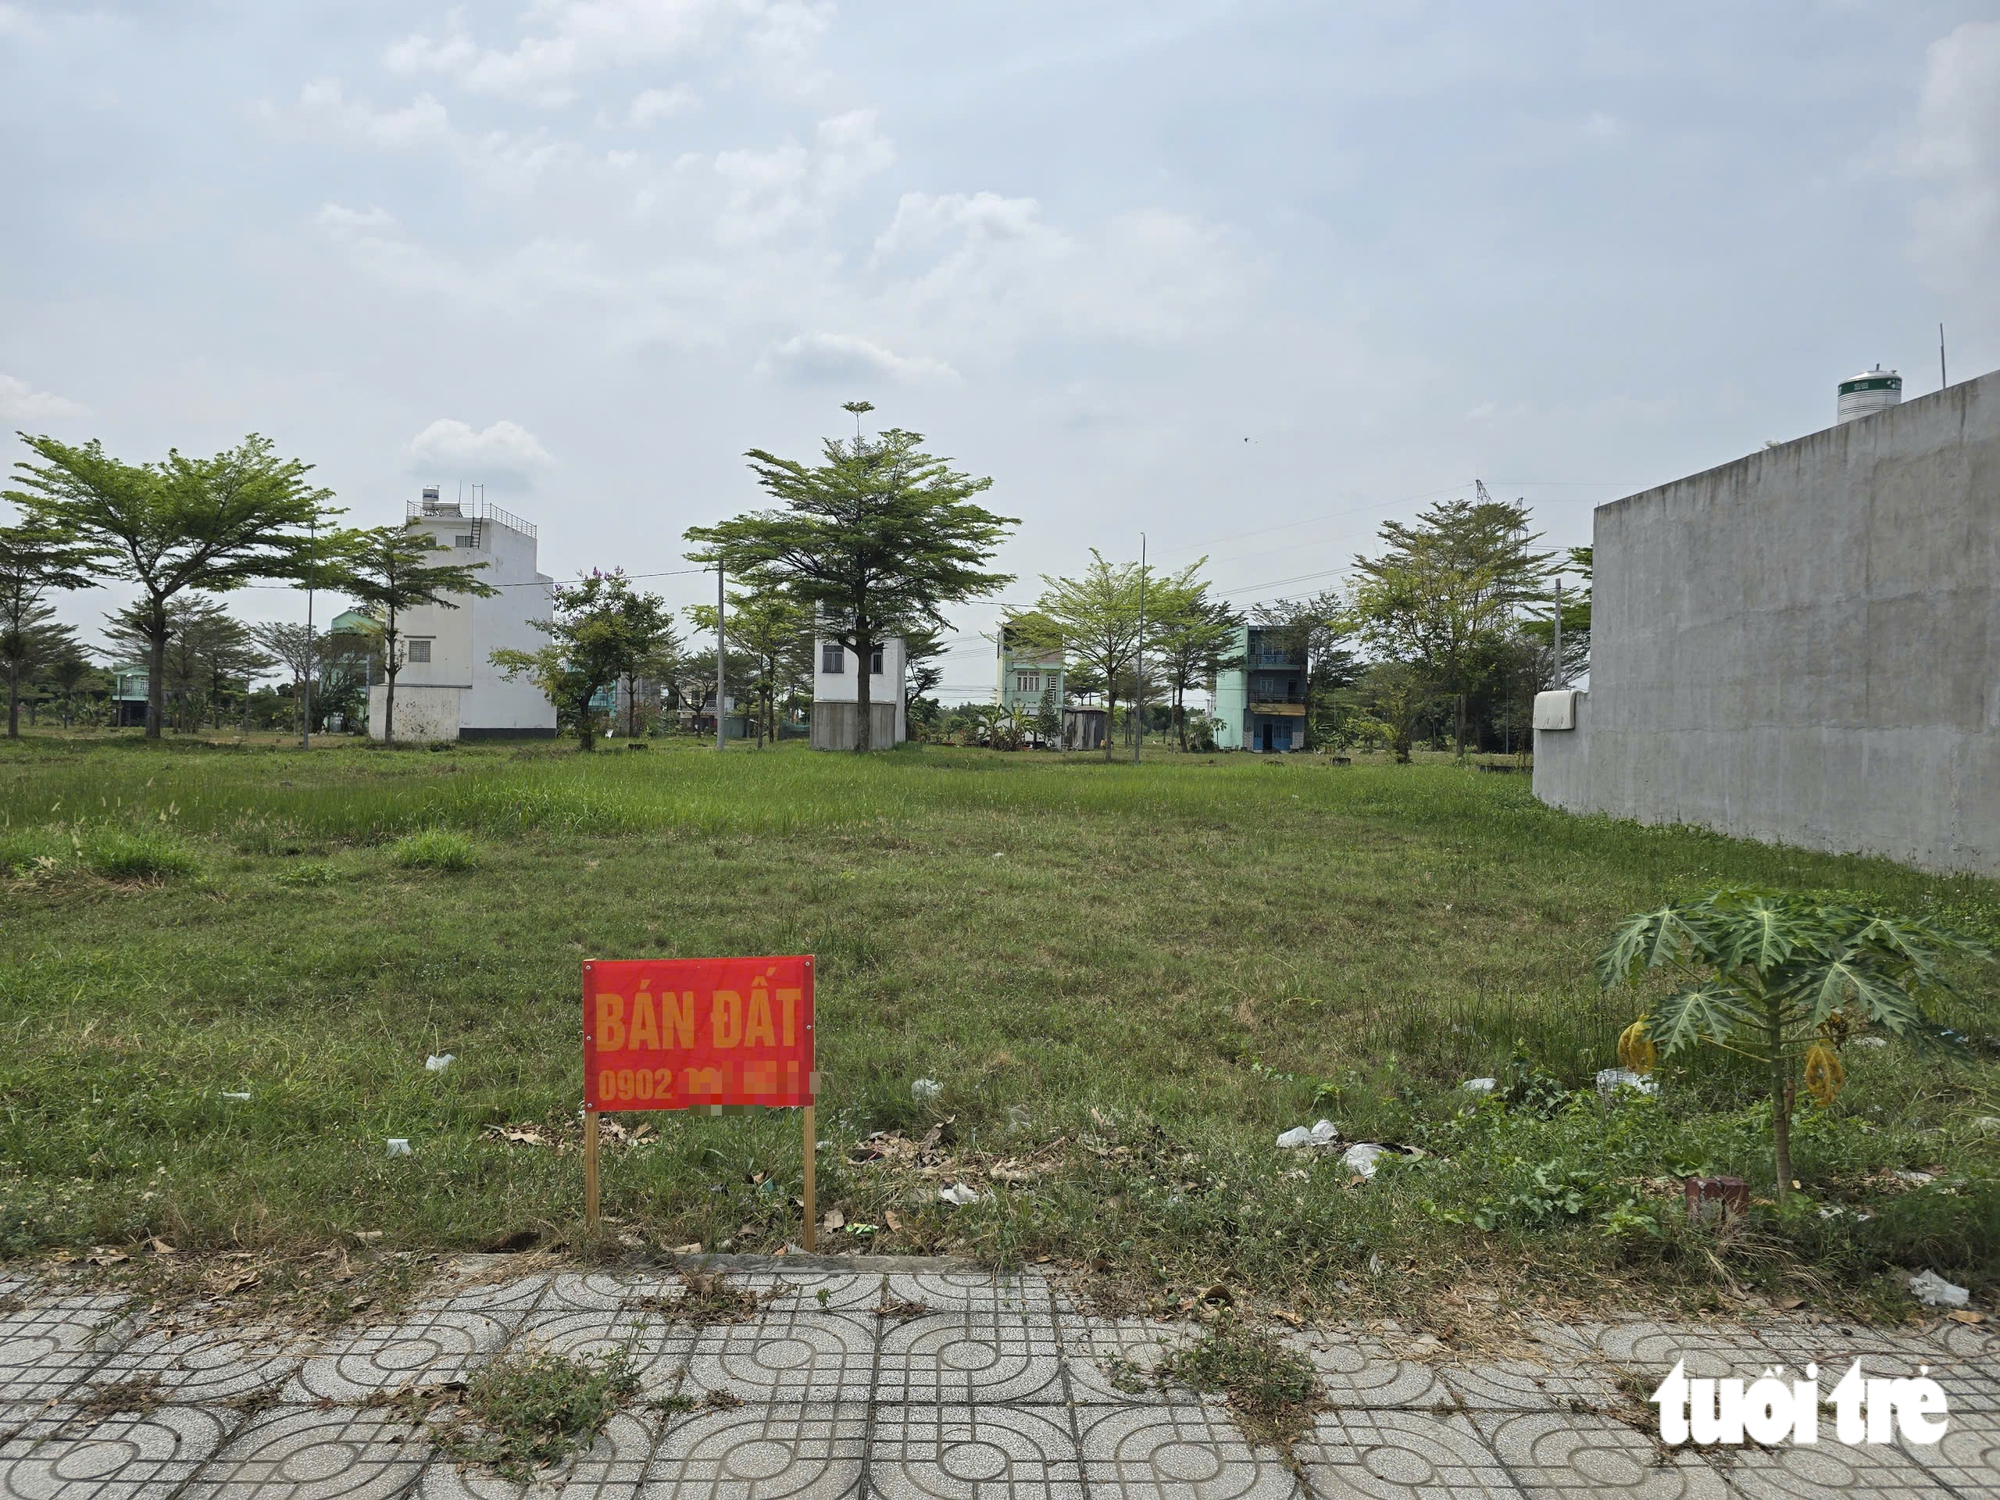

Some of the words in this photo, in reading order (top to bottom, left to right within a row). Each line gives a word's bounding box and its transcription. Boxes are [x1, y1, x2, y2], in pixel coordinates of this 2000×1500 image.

[595, 979, 695, 1052] BÁN
[710, 967, 802, 1049] ĐẤT
[599, 1067, 673, 1101] 0902
